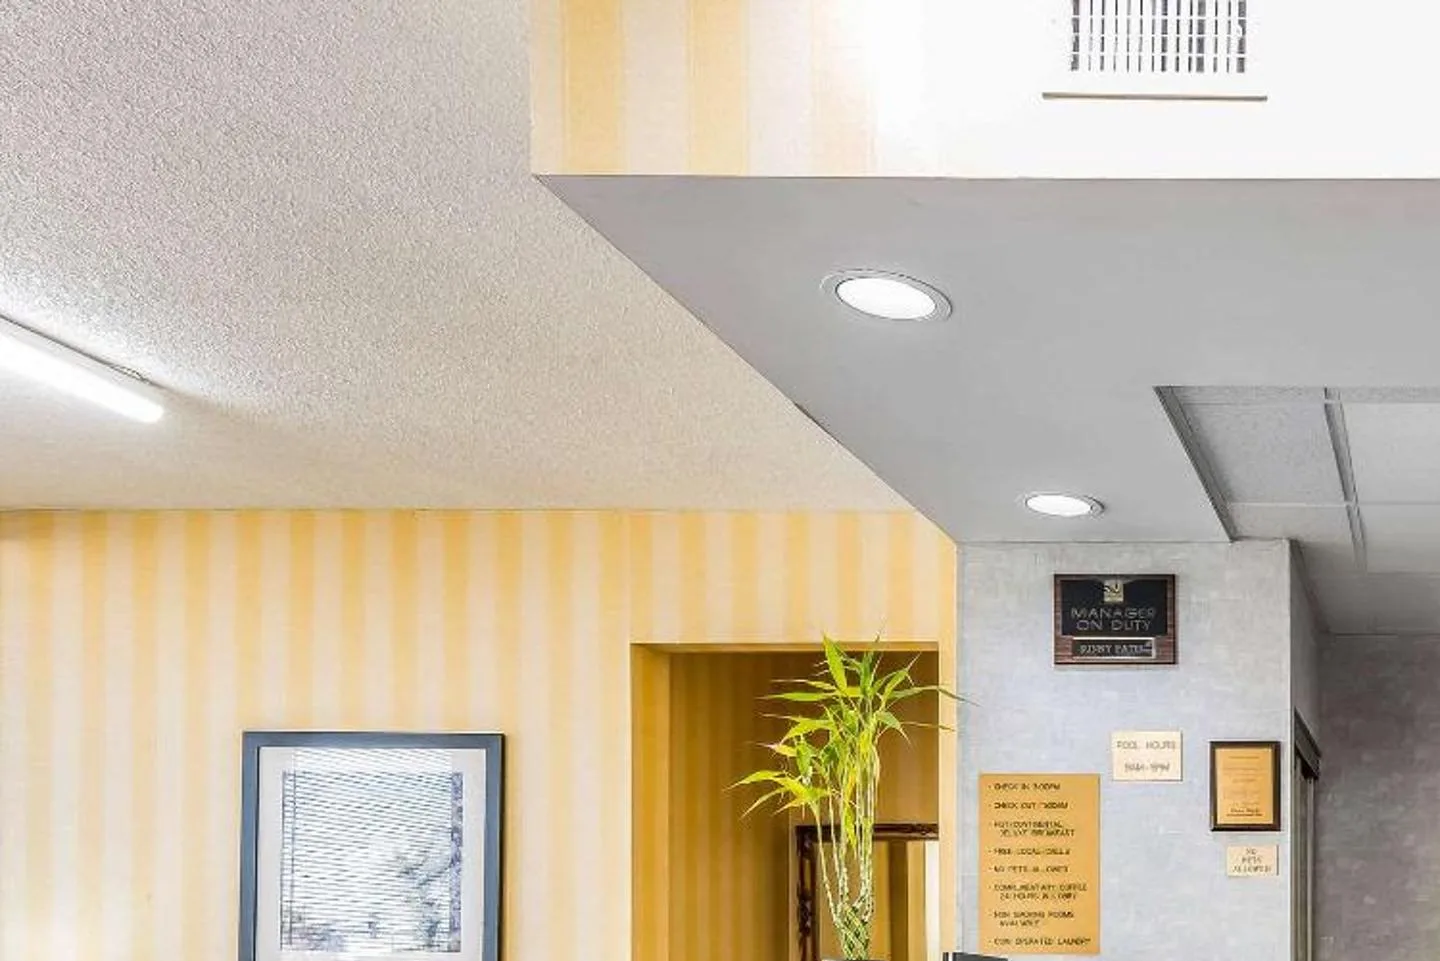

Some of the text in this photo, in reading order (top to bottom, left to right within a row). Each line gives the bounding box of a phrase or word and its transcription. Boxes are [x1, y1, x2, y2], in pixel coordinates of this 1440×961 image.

[1071, 606, 1155, 619] MANAGER
[1076, 620, 1151, 632] ON DUTY
[1116, 740, 1138, 750] POOL
